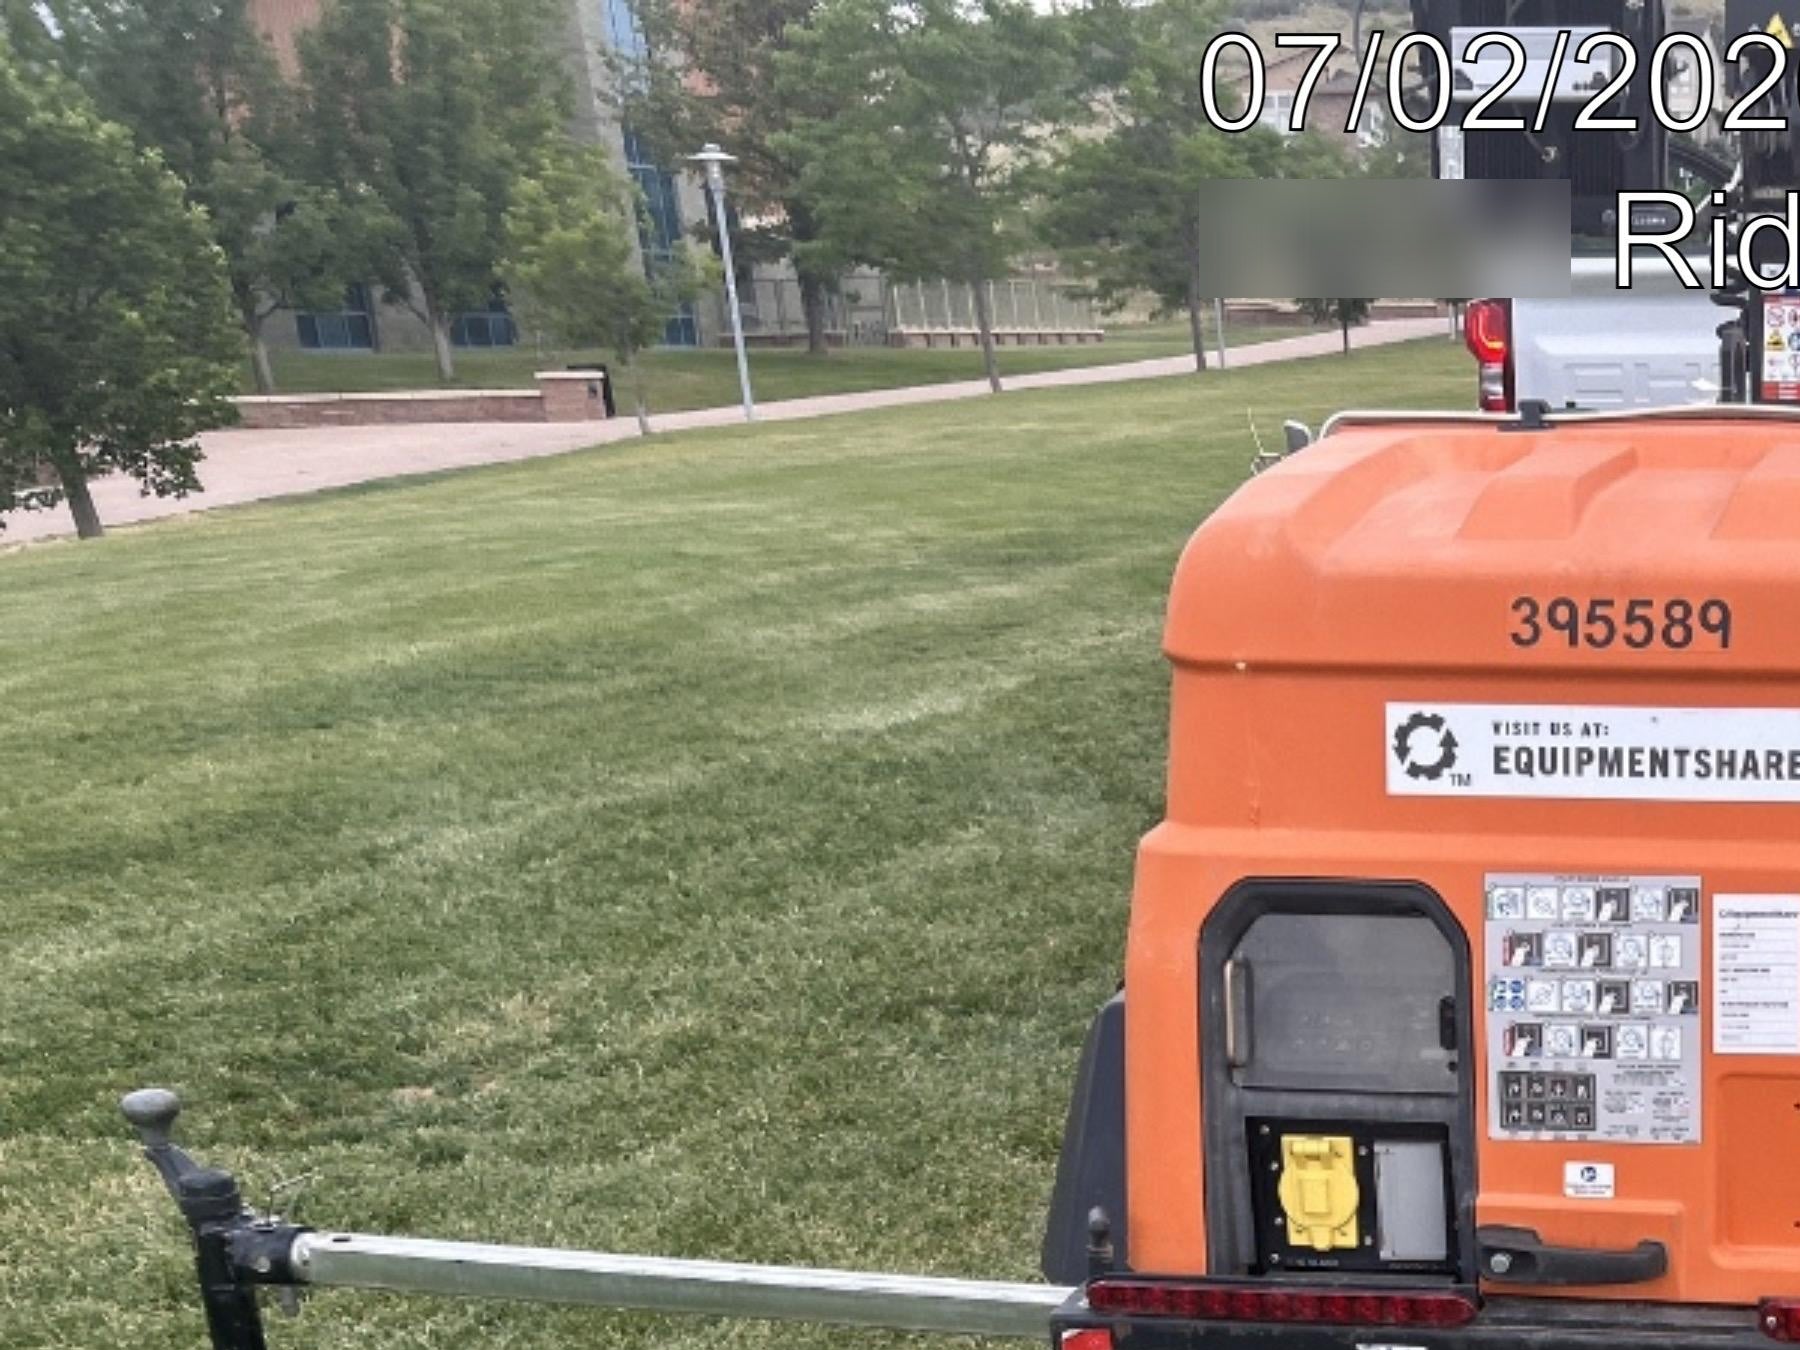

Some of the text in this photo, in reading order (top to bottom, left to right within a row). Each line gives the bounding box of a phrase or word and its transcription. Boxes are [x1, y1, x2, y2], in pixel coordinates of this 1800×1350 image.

[1510, 596, 1733, 649] 395589
[1492, 720, 1610, 738] VISIT US AT:
[1450, 774, 1472, 787] TM
